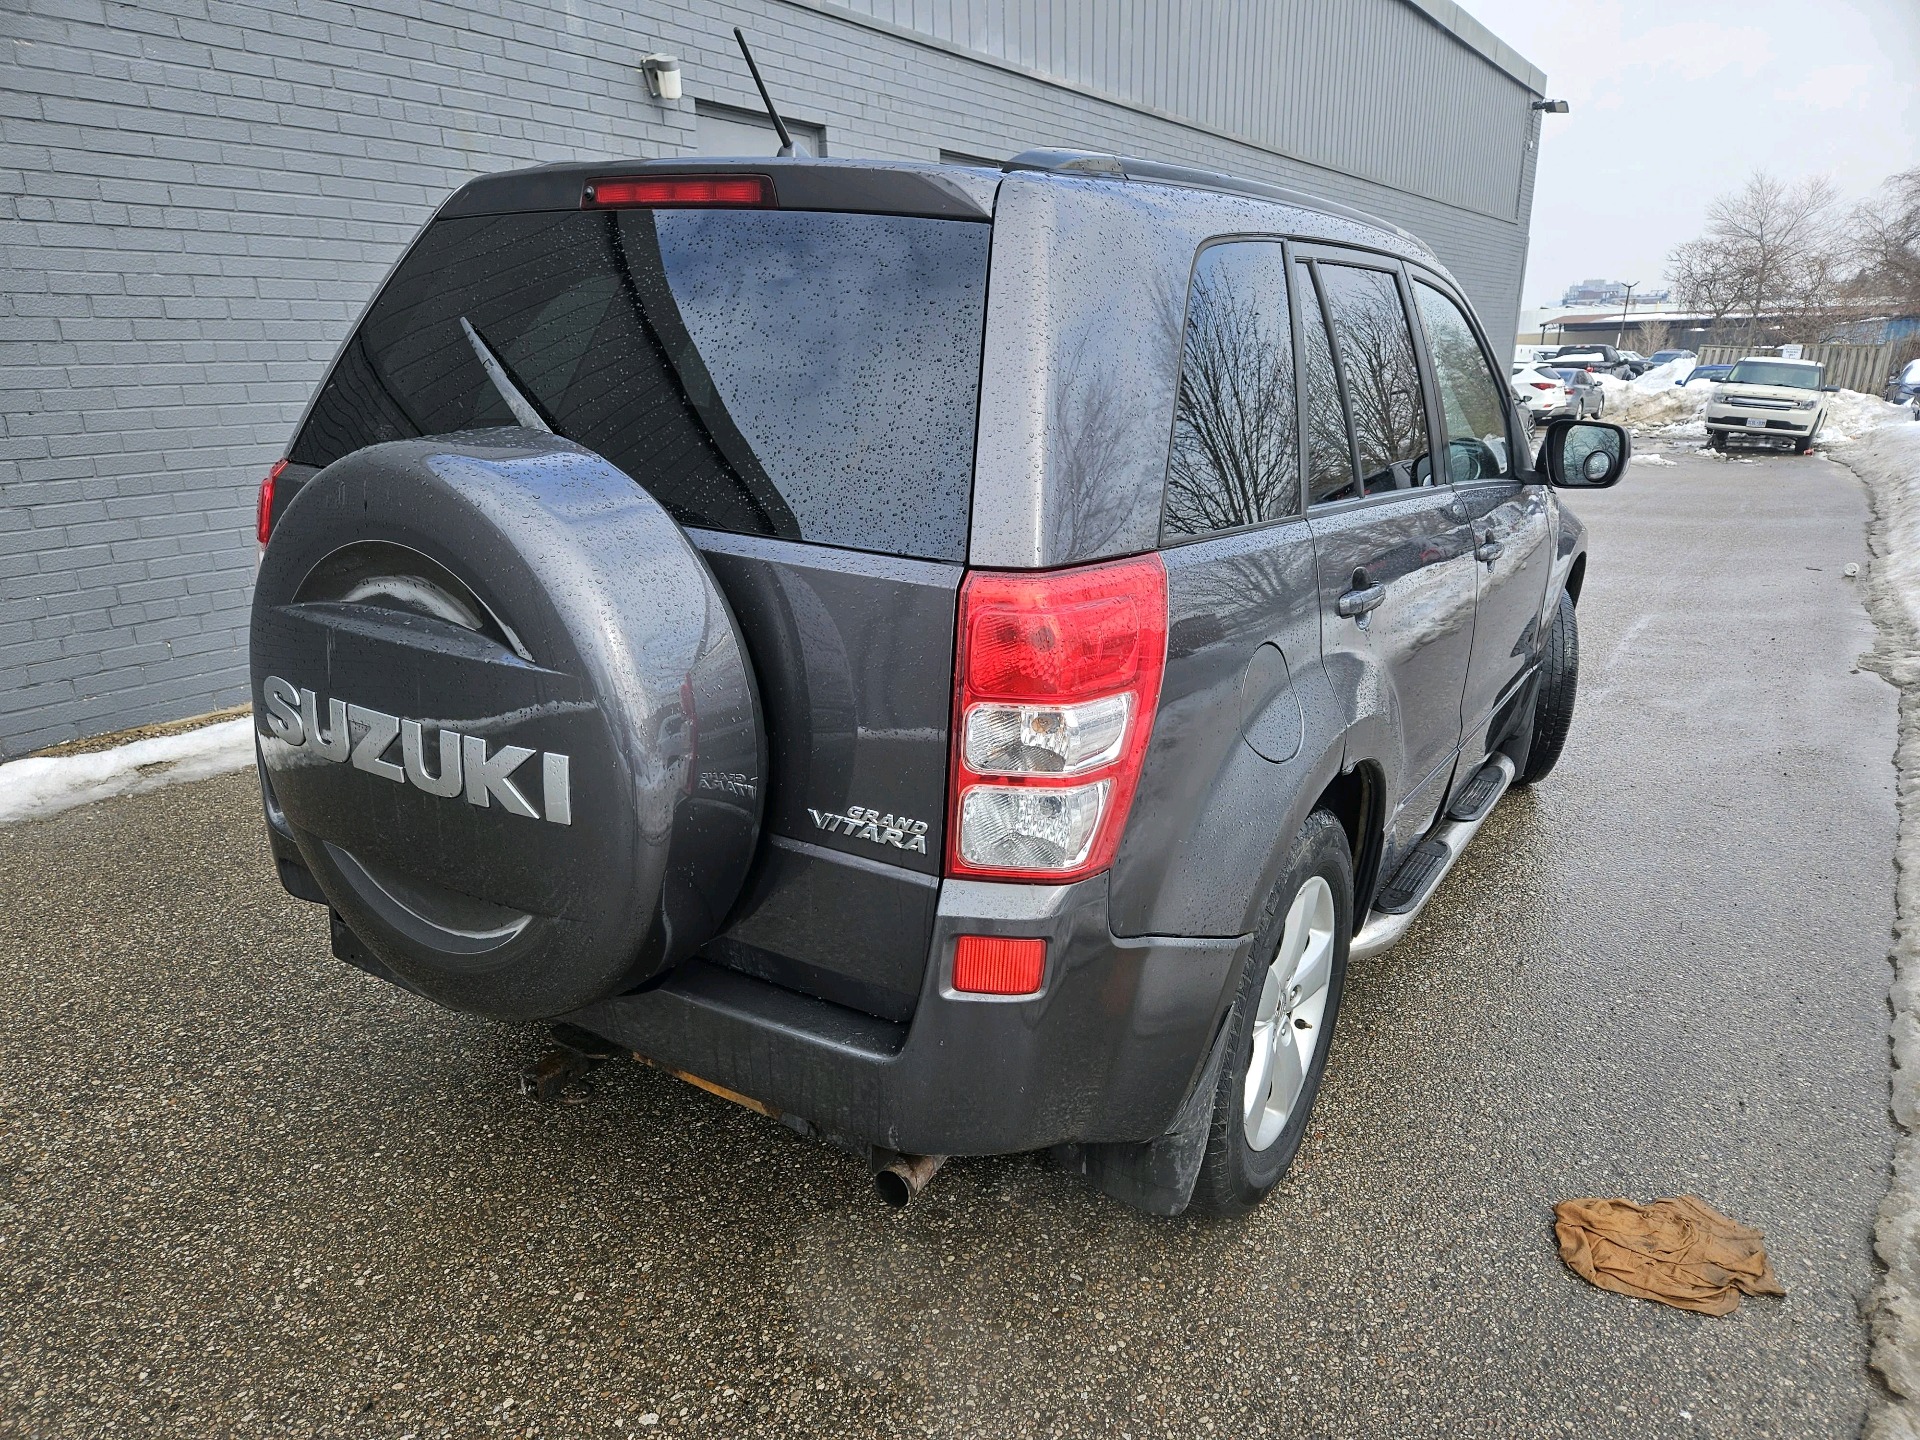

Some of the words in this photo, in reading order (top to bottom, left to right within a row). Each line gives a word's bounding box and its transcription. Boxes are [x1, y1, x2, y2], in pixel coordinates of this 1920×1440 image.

[263, 675, 572, 825] SUZUKI
[807, 808, 928, 855] VITARA
[846, 805, 929, 835] GRAND
